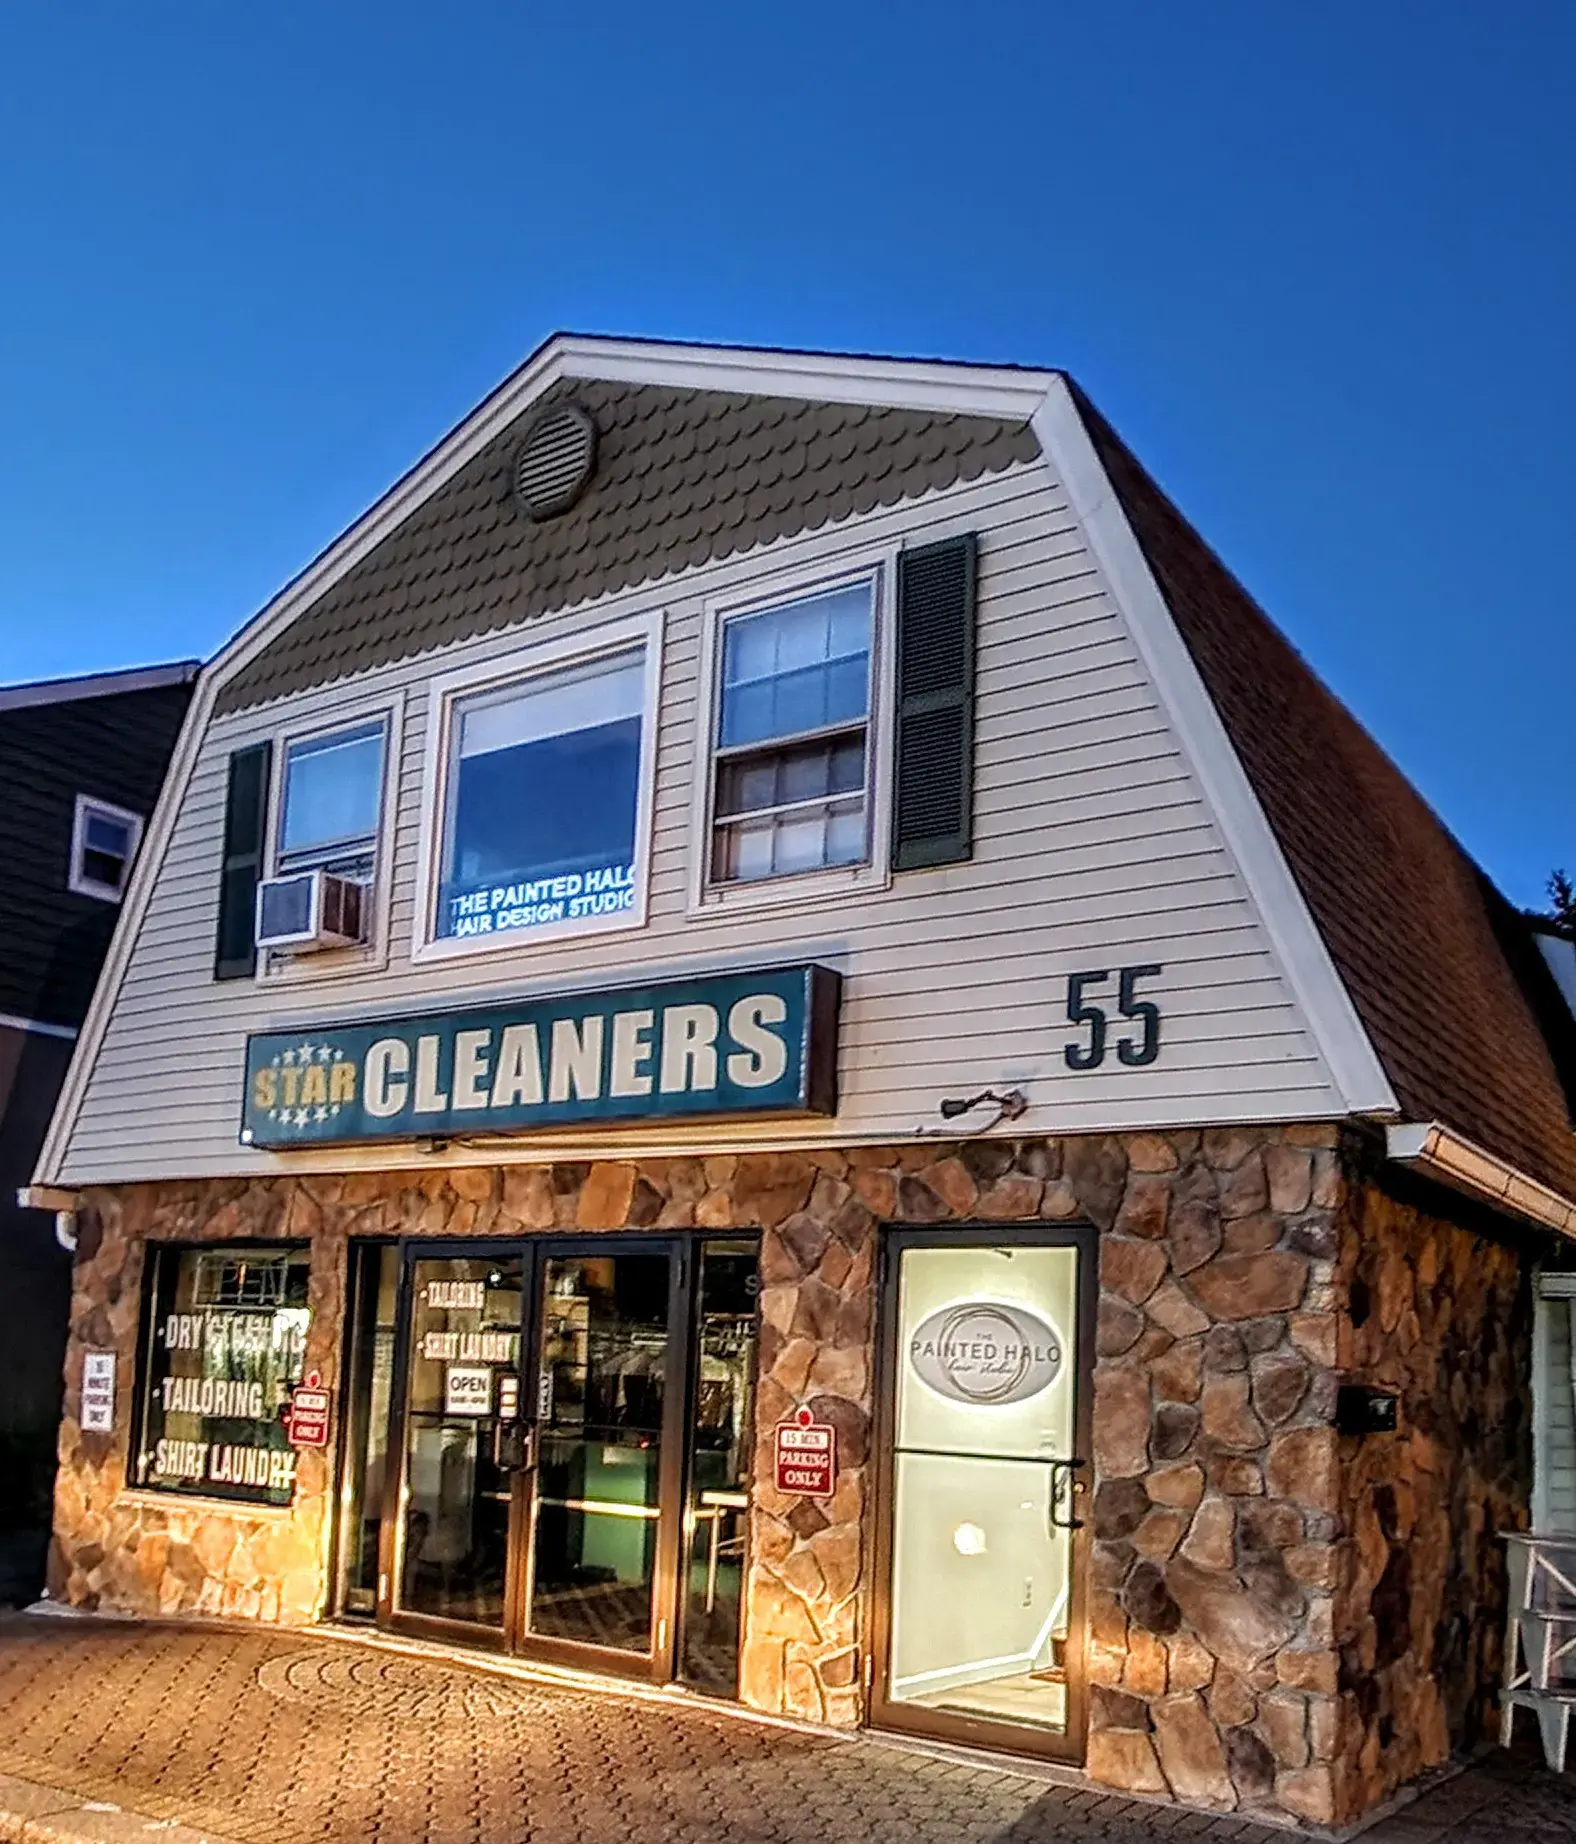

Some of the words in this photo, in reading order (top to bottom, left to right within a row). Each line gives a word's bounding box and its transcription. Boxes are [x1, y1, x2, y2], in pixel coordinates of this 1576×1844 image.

[450, 889, 489, 916] THE
[491, 875, 582, 910] PAINTED
[451, 913, 493, 938] HAIR
[496, 901, 564, 929] DESIGN
[1064, 964, 1162, 1070] 55
[254, 1061, 356, 1110] STAR
[363, 994, 788, 1118] CLEANERS
[164, 1314, 203, 1349] DRY
[911, 1340, 997, 1360] PAINTED
[1004, 1345, 1061, 1362] HALO
[163, 1376, 263, 1418] TAILORING
[450, 1376, 487, 1392] OPEN
[786, 1433, 798, 1445] 15
[156, 1438, 208, 1478] SHIRT
[210, 1444, 296, 1488] LAUNDRY
[779, 1451, 829, 1468] PARKING
[785, 1470, 823, 1487] ONLY
